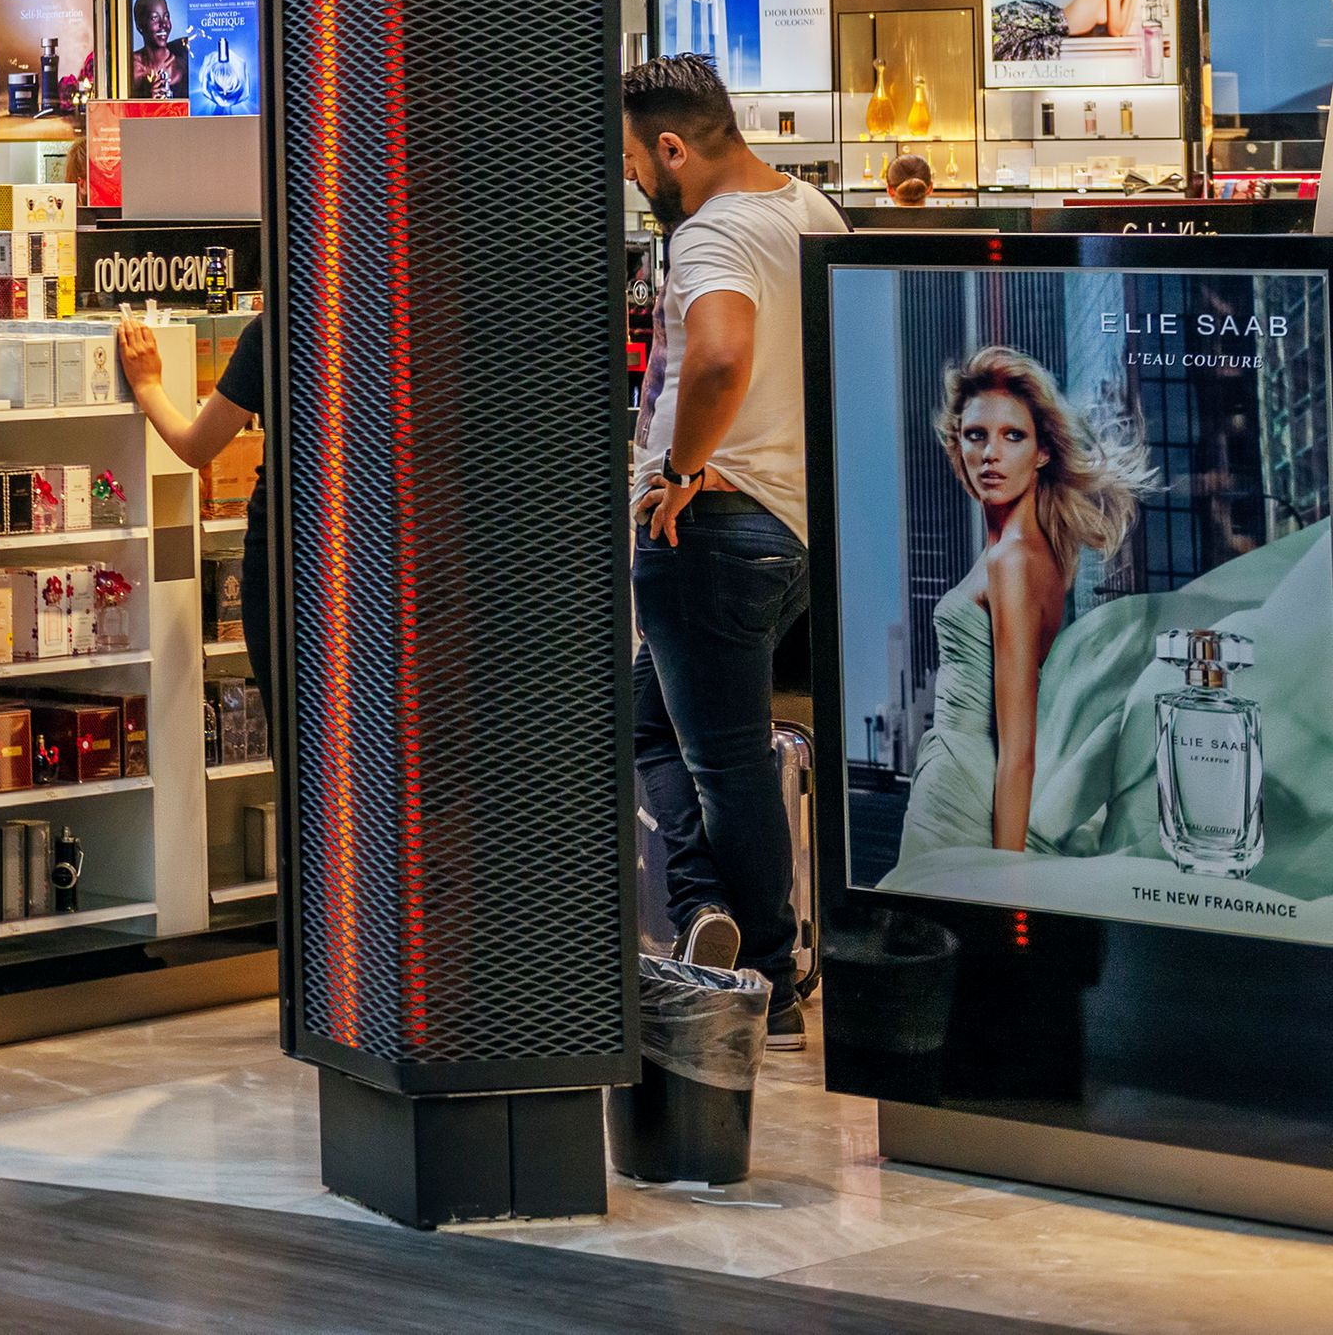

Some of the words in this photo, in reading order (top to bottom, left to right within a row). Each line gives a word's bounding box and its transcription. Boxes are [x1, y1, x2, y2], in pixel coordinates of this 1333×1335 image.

[764, 9, 788, 18] DIOR
[789, 7, 825, 17] HOMME
[201, 16, 246, 28] GÉNIFIQUE
[774, 18, 815, 27] COLOGNE
[994, 64, 1025, 80] Dior
[1029, 63, 1077, 79] Addict
[94, 250, 166, 294] roberto
[1100, 312, 1178, 335] ELIE
[1197, 313, 1289, 338] SAAB
[1128, 351, 1177, 367] L'EAU
[1182, 353, 1264, 370] COUTURE
[1171, 735, 1203, 748] ELIE
[1211, 739, 1249, 752] SAAB
[1201, 756, 1229, 764] PARFUM
[1132, 886, 1162, 903] THE
[1166, 889, 1199, 907] NEW
[1203, 894, 1297, 919] FRAGRANCE
